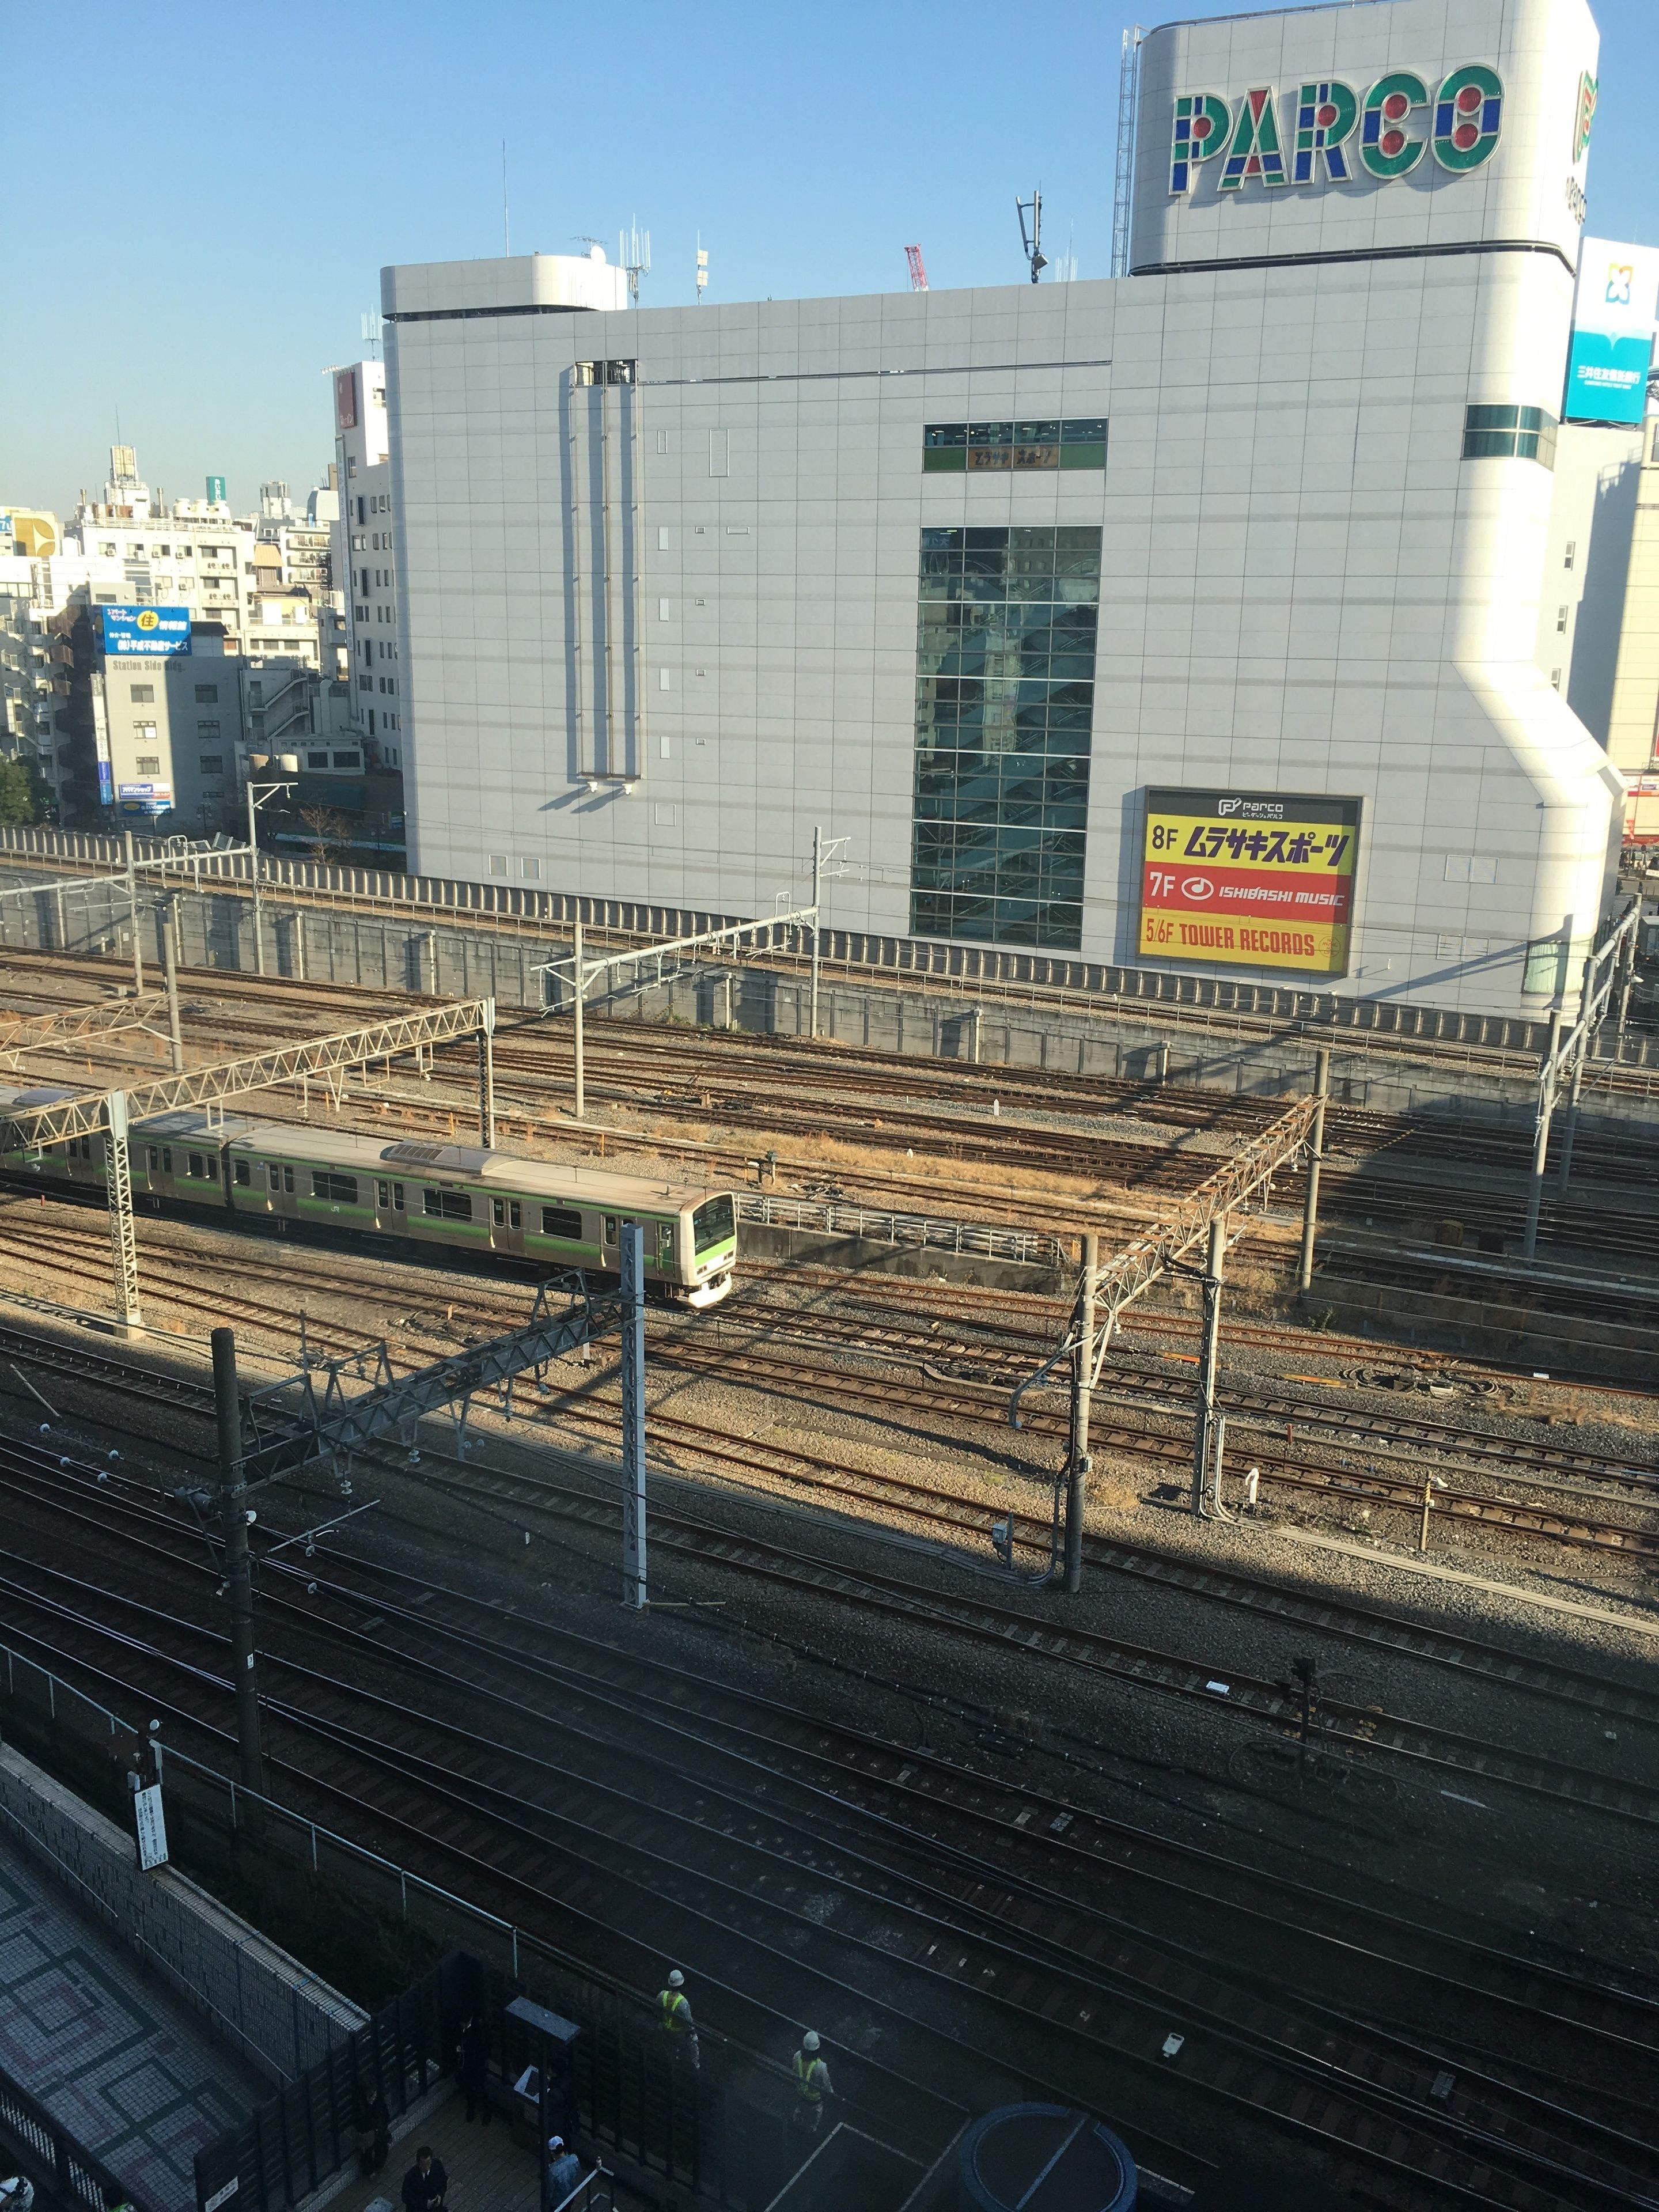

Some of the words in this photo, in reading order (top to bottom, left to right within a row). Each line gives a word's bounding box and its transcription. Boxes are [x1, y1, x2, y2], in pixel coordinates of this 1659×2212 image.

[1168, 62, 1505, 195] PARCO
[112, 660, 142, 671] Station
[145, 660, 162, 671] Side
[1152, 825, 1179, 850] 8F
[1184, 826, 1350, 866] ムラサキスポーツ
[1150, 872, 1176, 897] 7F
[1218, 887, 1293, 903] ISHIBASHI
[1295, 892, 1345, 906] MUSIC
[1146, 918, 1174, 944] 5/6F
[1179, 923, 1234, 949] TOWER
[1240, 929, 1315, 956] RECORDS
